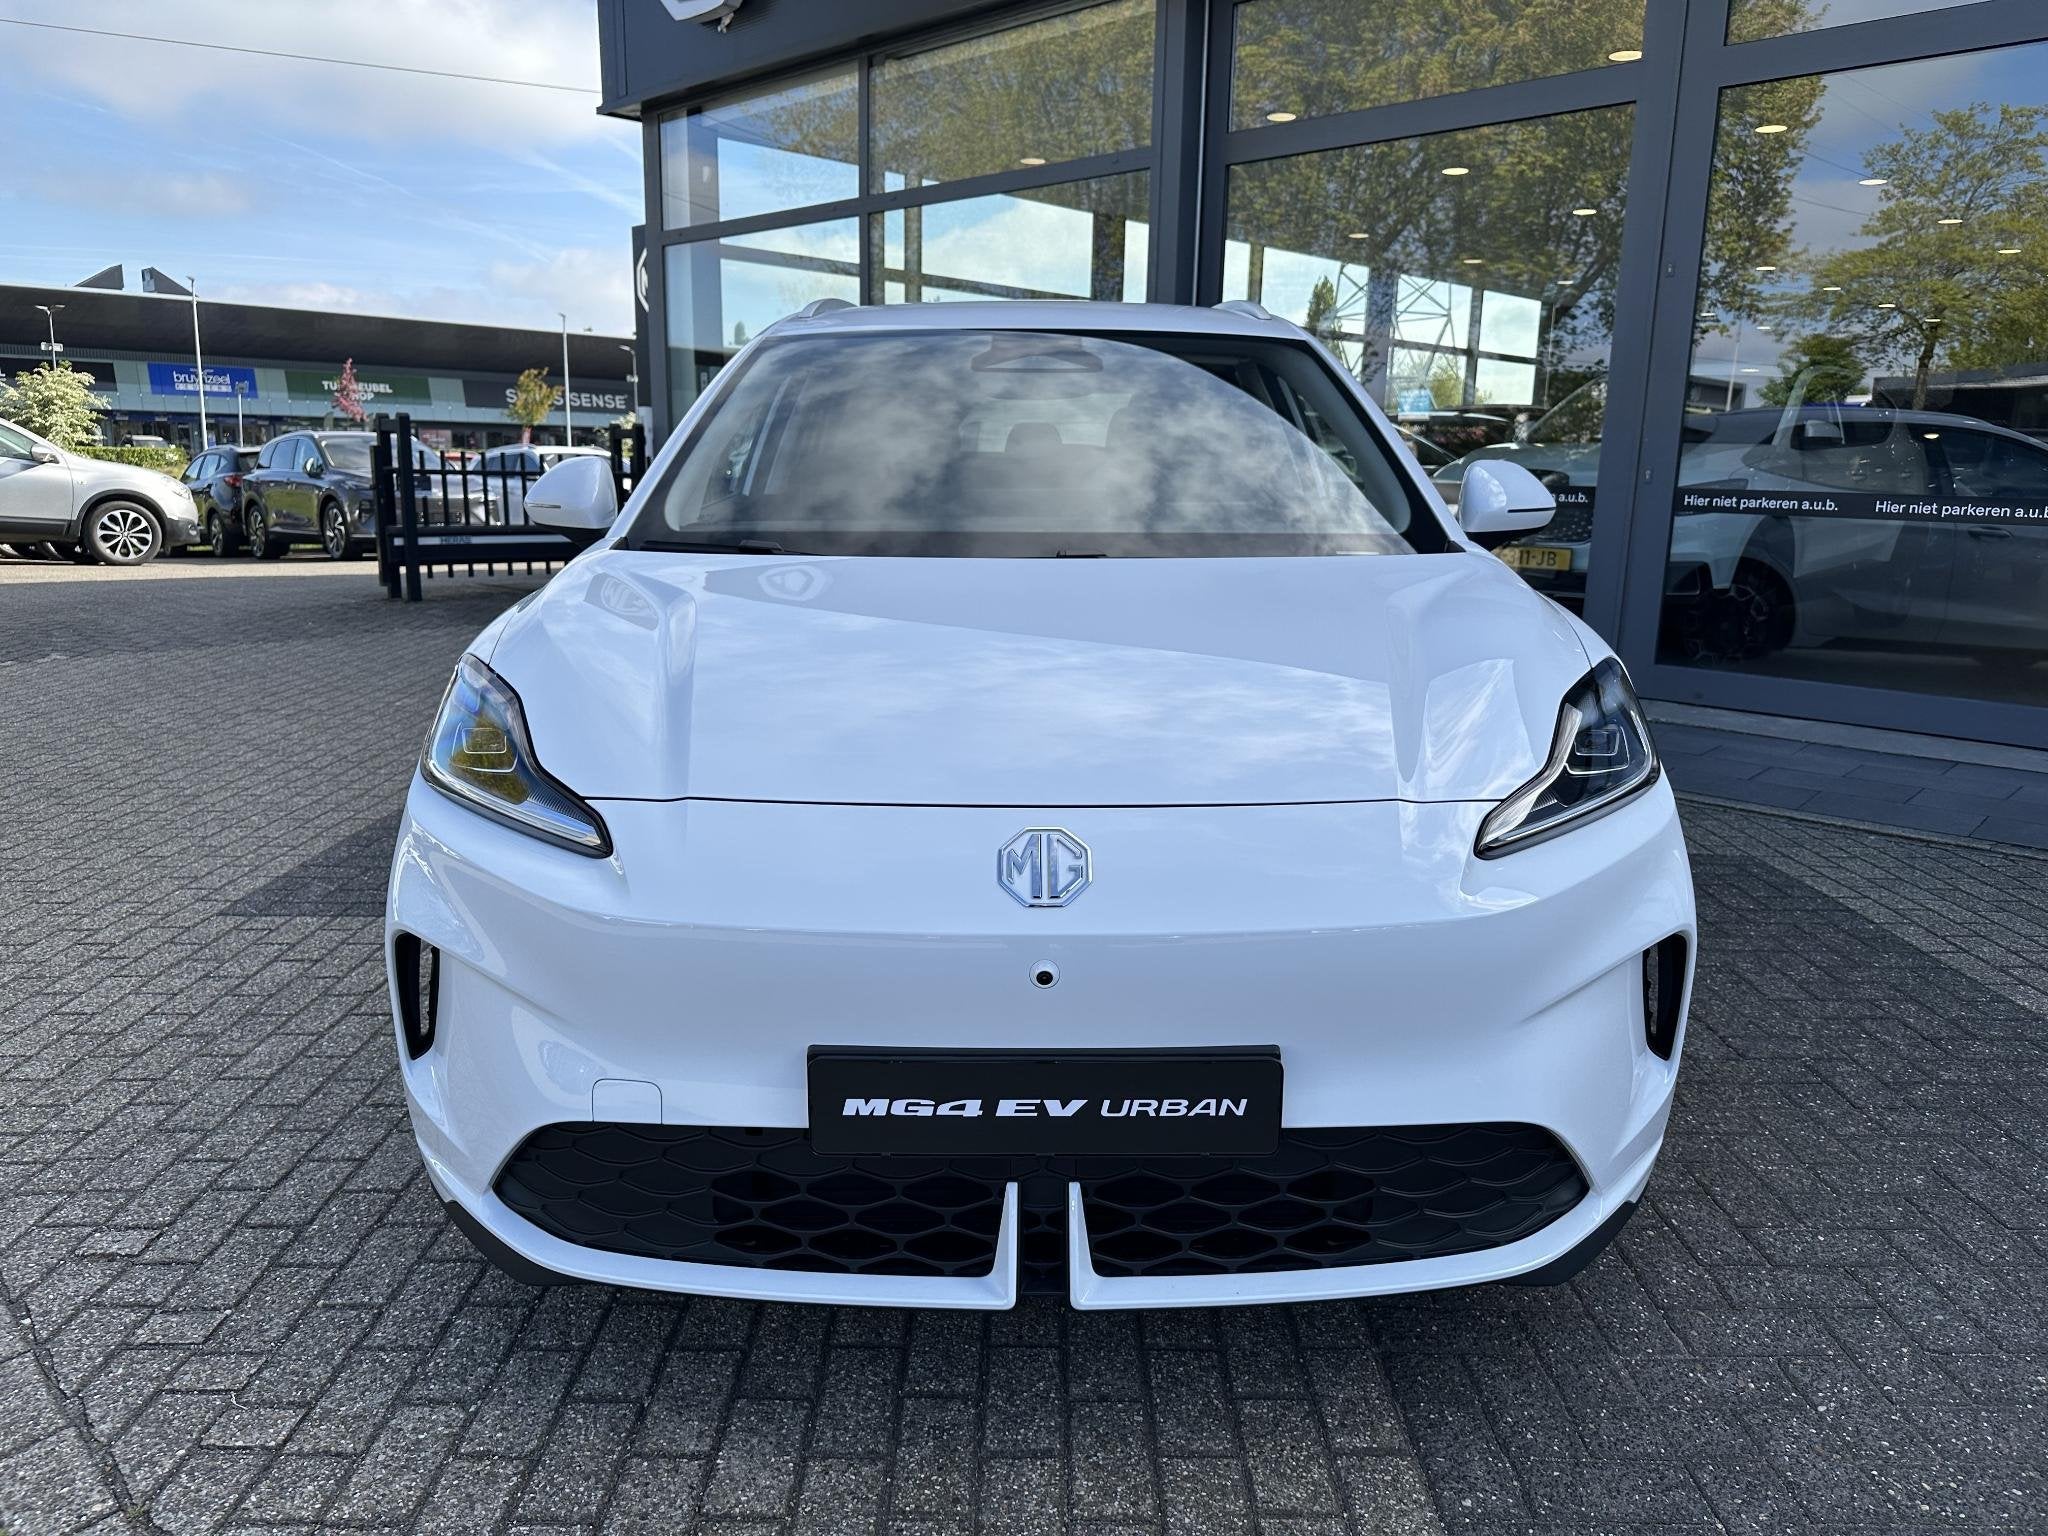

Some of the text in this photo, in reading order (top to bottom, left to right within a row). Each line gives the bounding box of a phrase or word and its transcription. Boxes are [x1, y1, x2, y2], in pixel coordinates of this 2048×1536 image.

[1558, 492, 1589, 503] a.u.b.
[1684, 494, 1838, 511] Hier niet parkeren a.u.b.
[1875, 500, 1906, 513] Hier
[1909, 502, 1938, 515] niet
[1941, 503, 2011, 518] parkeren
[1006, 833, 1083, 899] MG
[842, 1098, 1248, 1118] MG4 EV URBAN
